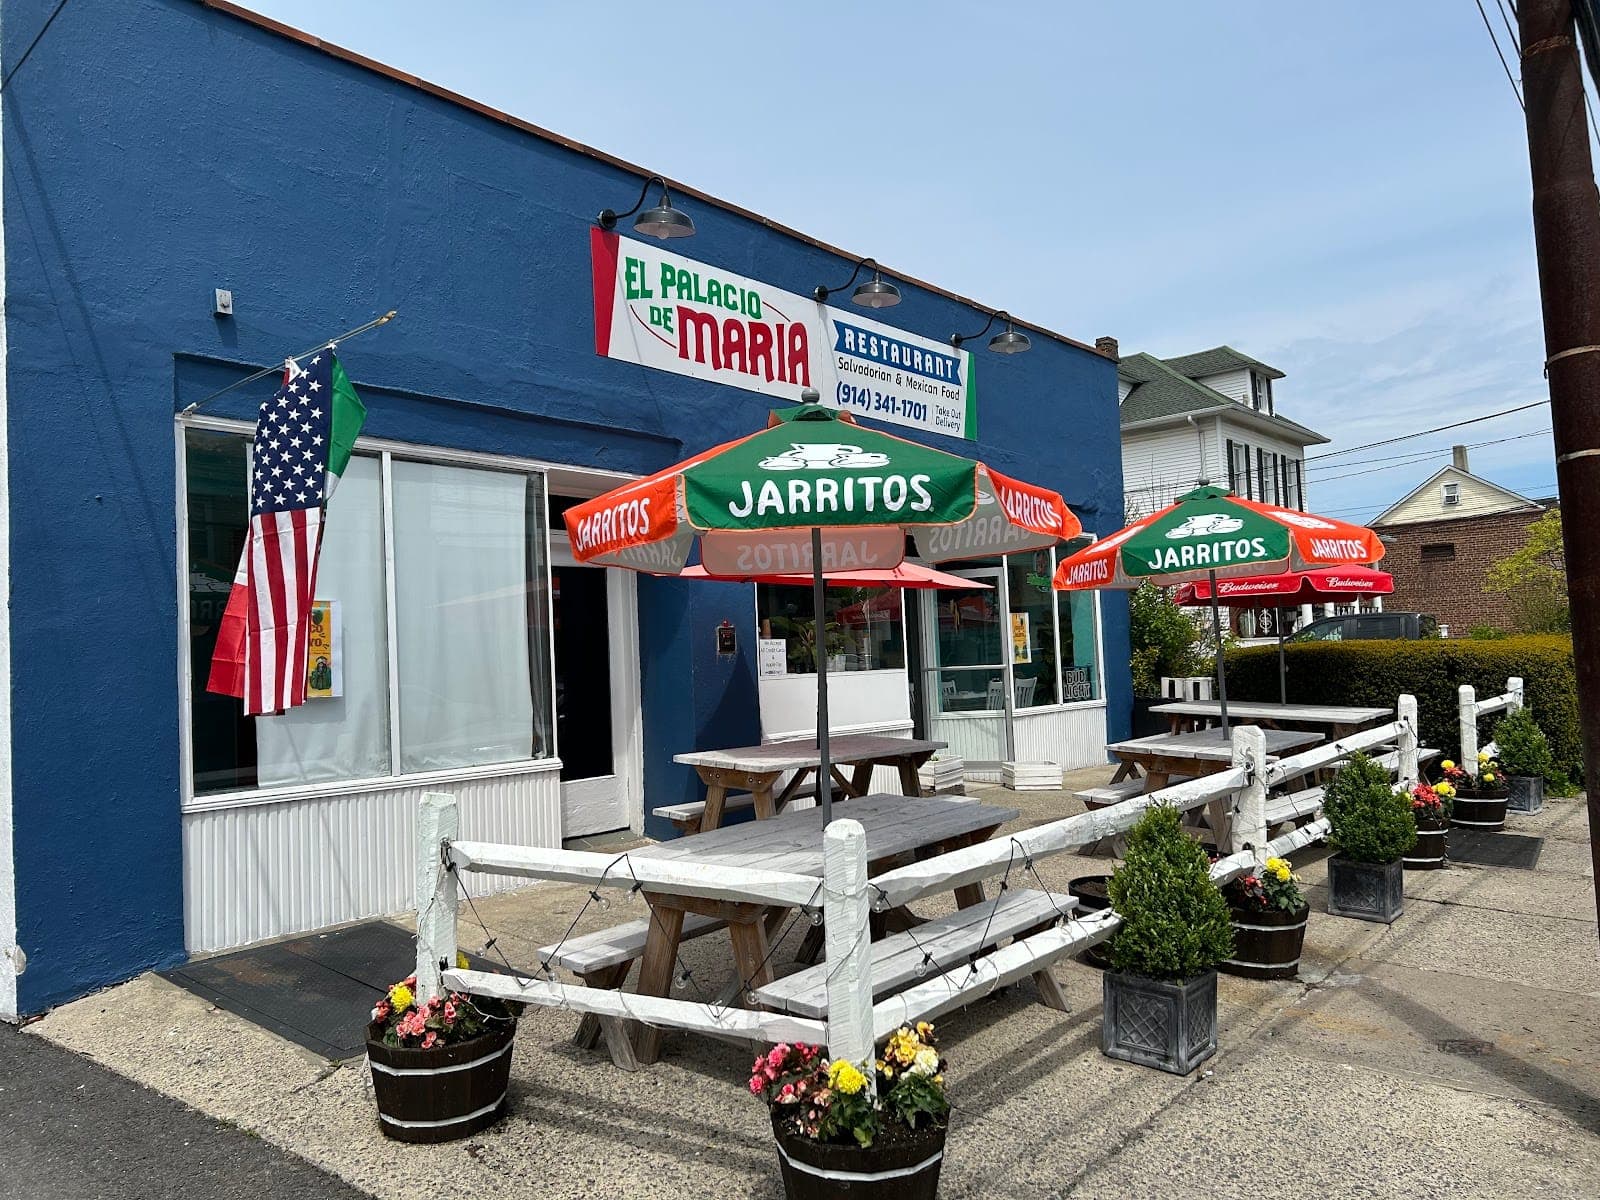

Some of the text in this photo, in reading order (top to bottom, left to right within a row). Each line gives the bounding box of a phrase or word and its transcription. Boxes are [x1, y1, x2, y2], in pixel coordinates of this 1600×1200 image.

[625, 256, 762, 320] EL PALACIO
[649, 305, 811, 388] DE MARIA
[844, 327, 953, 379] RESTAURANT
[838, 356, 960, 401] Salvadorian & Mexican Food
[836, 380, 927, 422] (914) 341-1701
[936, 404, 961, 420] Take Out
[935, 415, 961, 432] Delivery
[728, 474, 932, 518] JARRITOS
[576, 497, 651, 552] JARRITOS
[1148, 537, 1267, 570] JARRITOS
[1310, 537, 1367, 559] JARRITOS
[1066, 558, 1108, 585] JARRITOS
[1326, 577, 1376, 588] Budweiser
[1218, 581, 1280, 593] Budweiser
[1063, 683, 1091, 700] LIGHT
[1066, 669, 1087, 685] BUD
